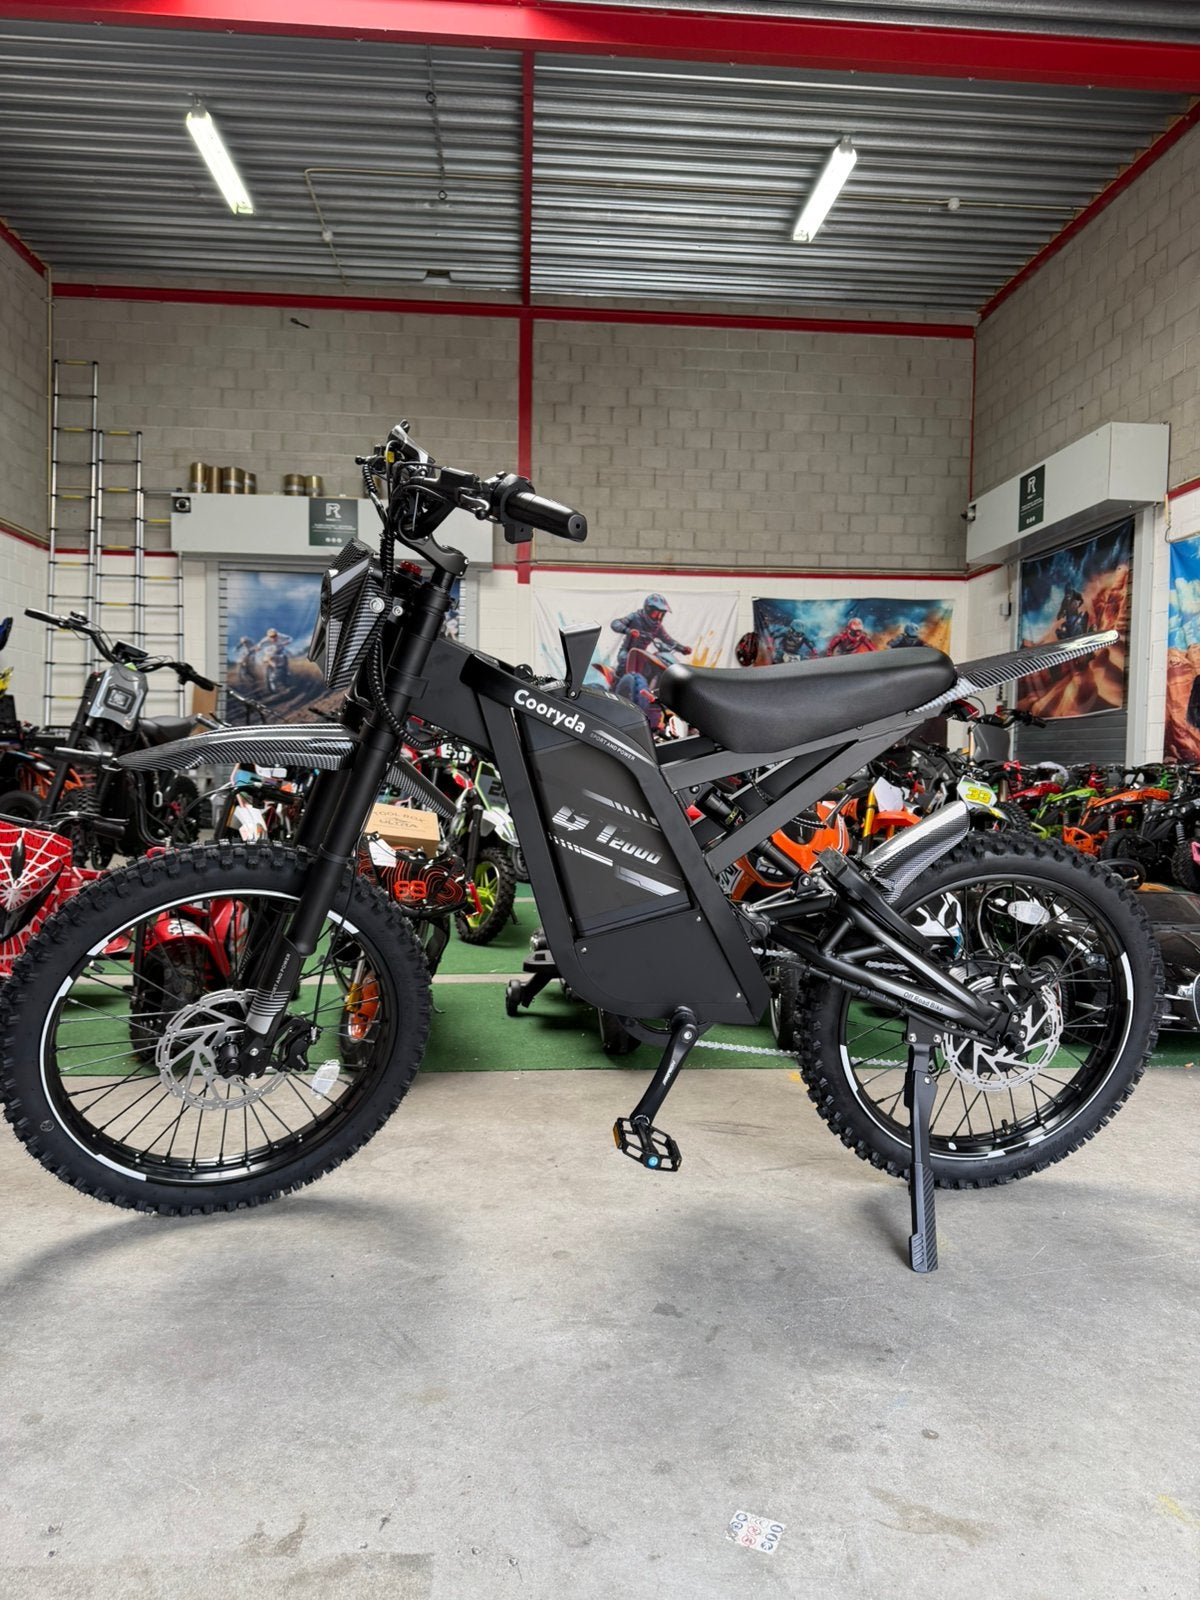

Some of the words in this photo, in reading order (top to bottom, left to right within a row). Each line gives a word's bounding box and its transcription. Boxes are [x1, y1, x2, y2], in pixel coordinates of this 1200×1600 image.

[325, 502, 342, 518] R
[514, 689, 586, 733] Cooryda
[606, 743, 618, 751] AND
[616, 747, 636, 761] POWER
[966, 787, 992, 804] 33
[608, 837, 662, 865] 2000
[280, 953, 291, 973] POWER
[914, 996, 930, 1006] Road
[929, 1003, 943, 1011] Bike
